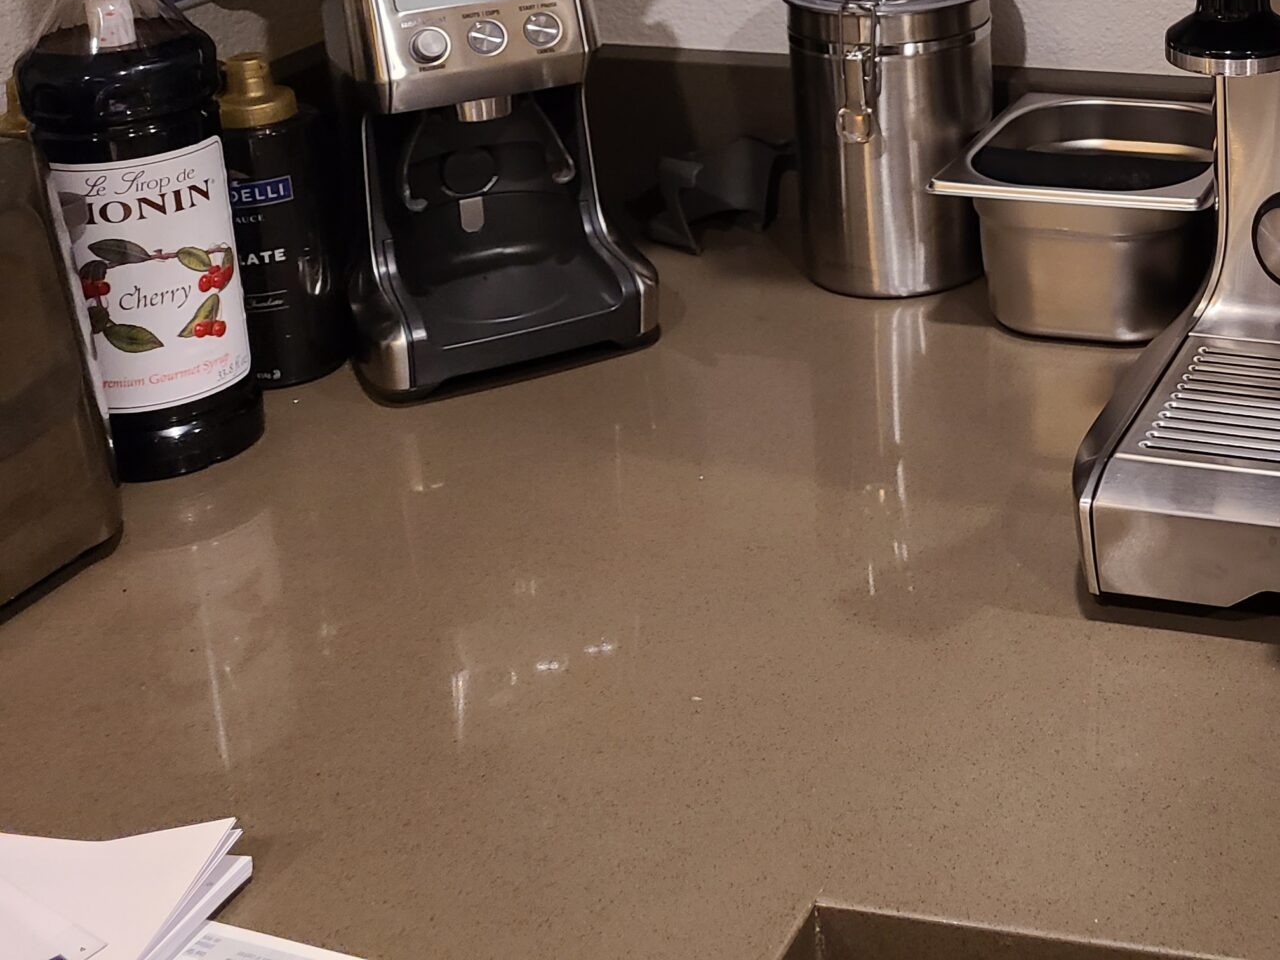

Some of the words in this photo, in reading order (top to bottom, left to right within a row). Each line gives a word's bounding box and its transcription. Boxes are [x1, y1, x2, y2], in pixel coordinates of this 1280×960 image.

[84, 175, 107, 197] Le
[114, 170, 171, 195] Sirop
[176, 168, 196, 183] de
[235, 213, 264, 224] AUCE
[118, 284, 192, 311] Cherry
[102, 377, 145, 389] remium
[148, 365, 200, 385] Gourmet
